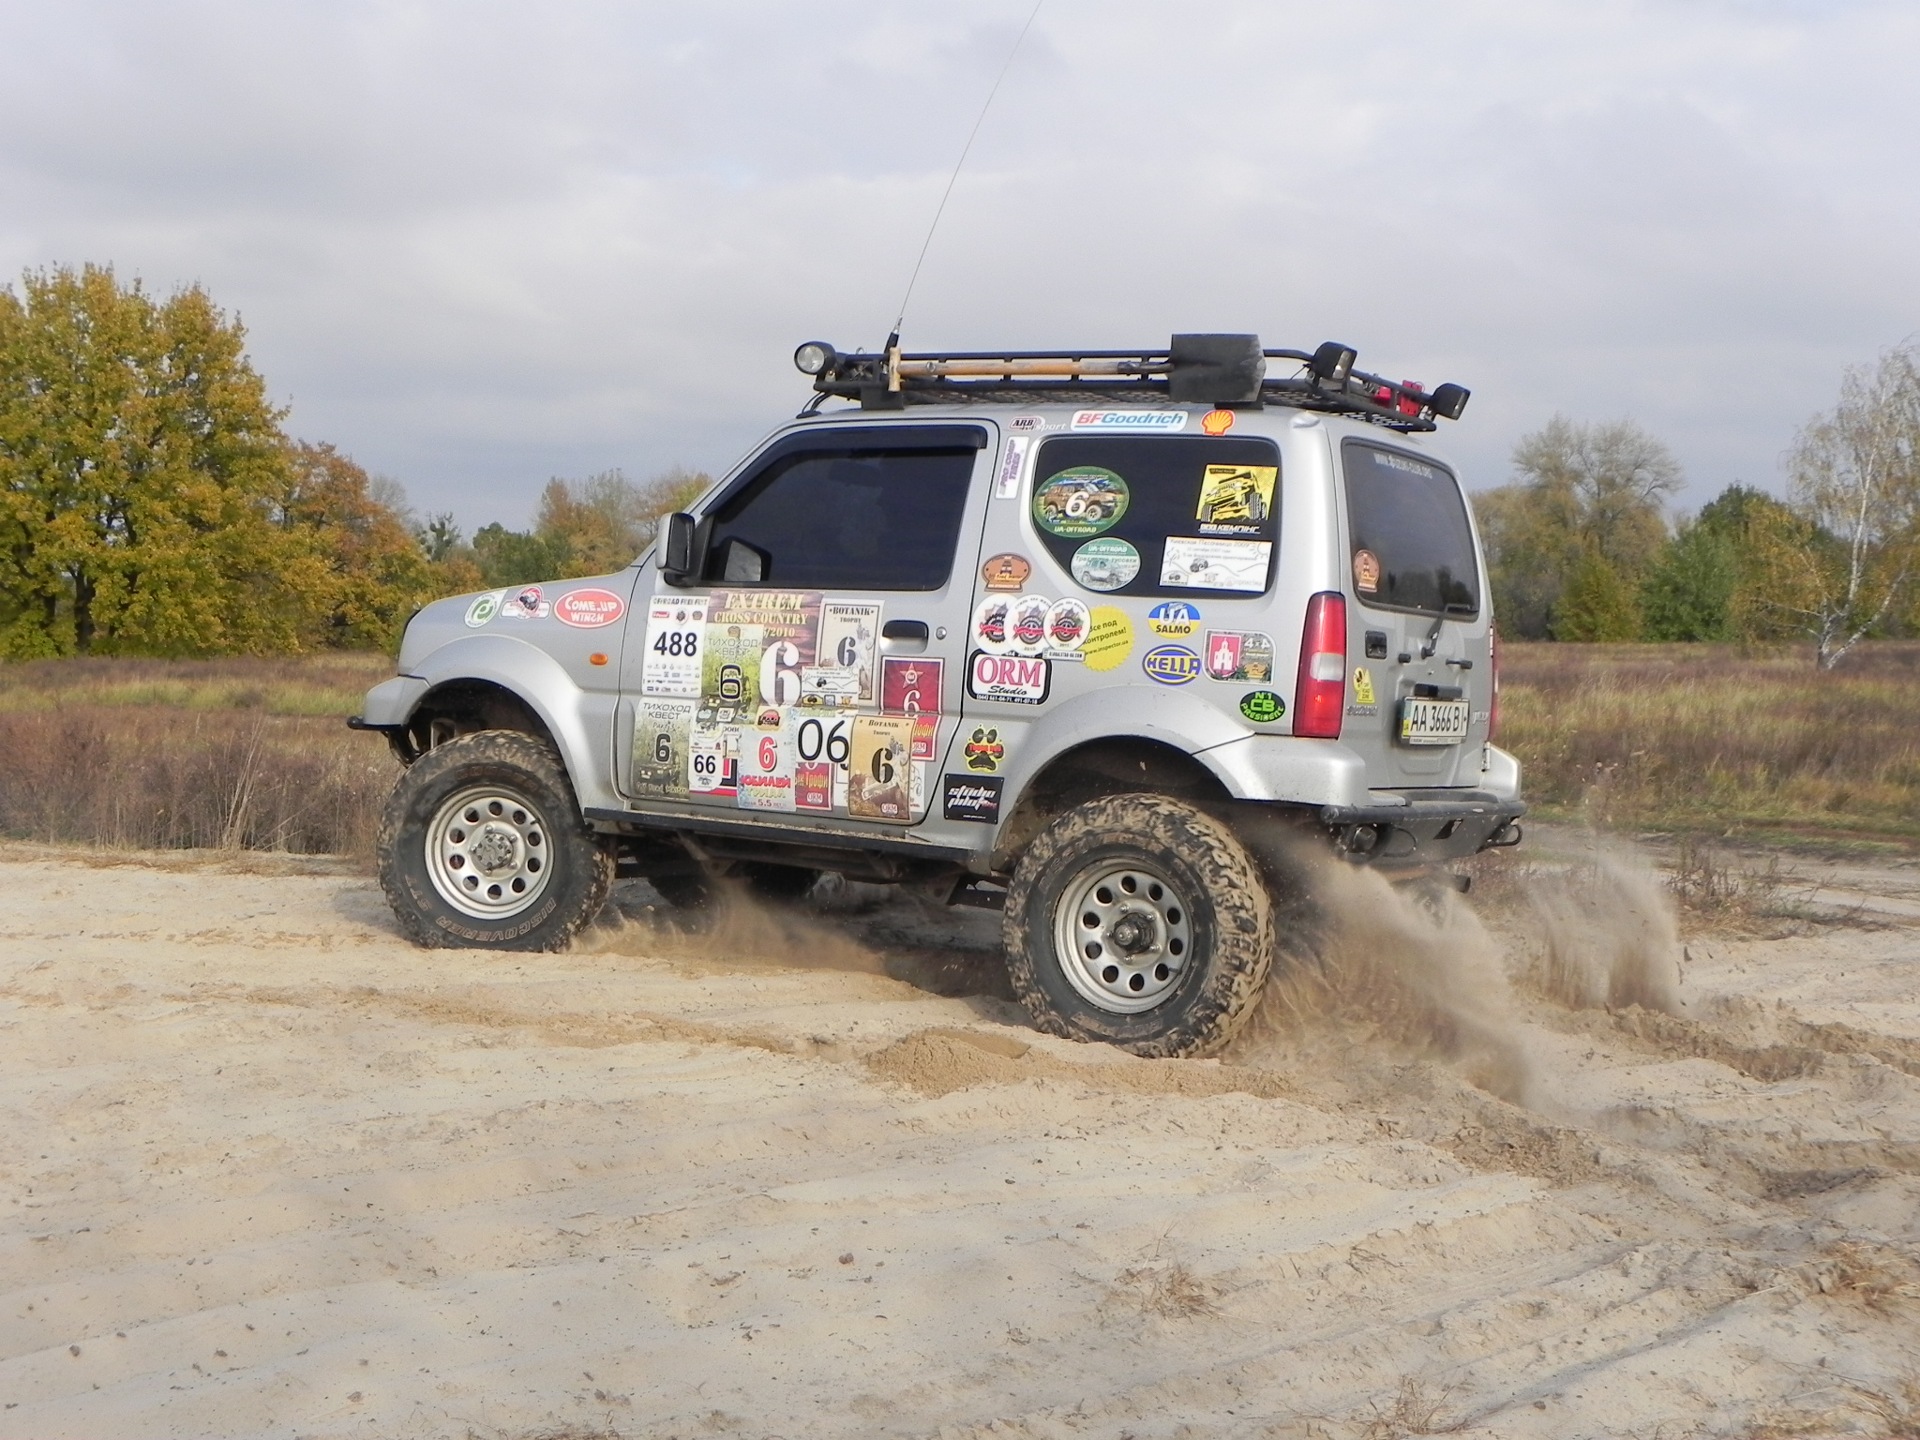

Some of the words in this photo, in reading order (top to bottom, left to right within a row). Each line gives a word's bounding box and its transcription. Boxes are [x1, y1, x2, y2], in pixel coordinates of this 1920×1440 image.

[1012, 419, 1034, 427] ARB
[1076, 413, 1185, 425] BFGoodrich
[1065, 490, 1090, 518] 6
[1054, 526, 1097, 534] UA-OFFROAD
[724, 592, 804, 610] EXTREM
[714, 611, 752, 624] CROSS
[753, 612, 809, 625] COUNTRY
[833, 607, 871, 616] BOTANIK
[1158, 607, 1190, 625] UA
[1102, 620, 1118, 629] под
[1156, 624, 1191, 634] SALMO
[654, 631, 698, 656] 488
[708, 638, 758, 648] ТИХОХОД
[837, 636, 856, 667] 6
[759, 641, 801, 707] 6
[977, 656, 1043, 688] ORM
[1147, 656, 1201, 676] HELLA
[720, 664, 742, 700] 6
[988, 686, 1028, 696] Studio
[643, 702, 692, 714] ТИХОХОД
[1240, 702, 1284, 722] PRESIDENT
[1250, 698, 1275, 712] CB
[648, 711, 681, 720] КВЕСТ
[1410, 704, 1427, 732] AA
[1430, 704, 1452, 732] 3666
[655, 733, 671, 764] 6
[798, 718, 850, 763] 06
[694, 754, 716, 774] 66
[759, 736, 778, 773] 6
[871, 747, 894, 784] 6
[436, 898, 557, 942] DISCOVERER
